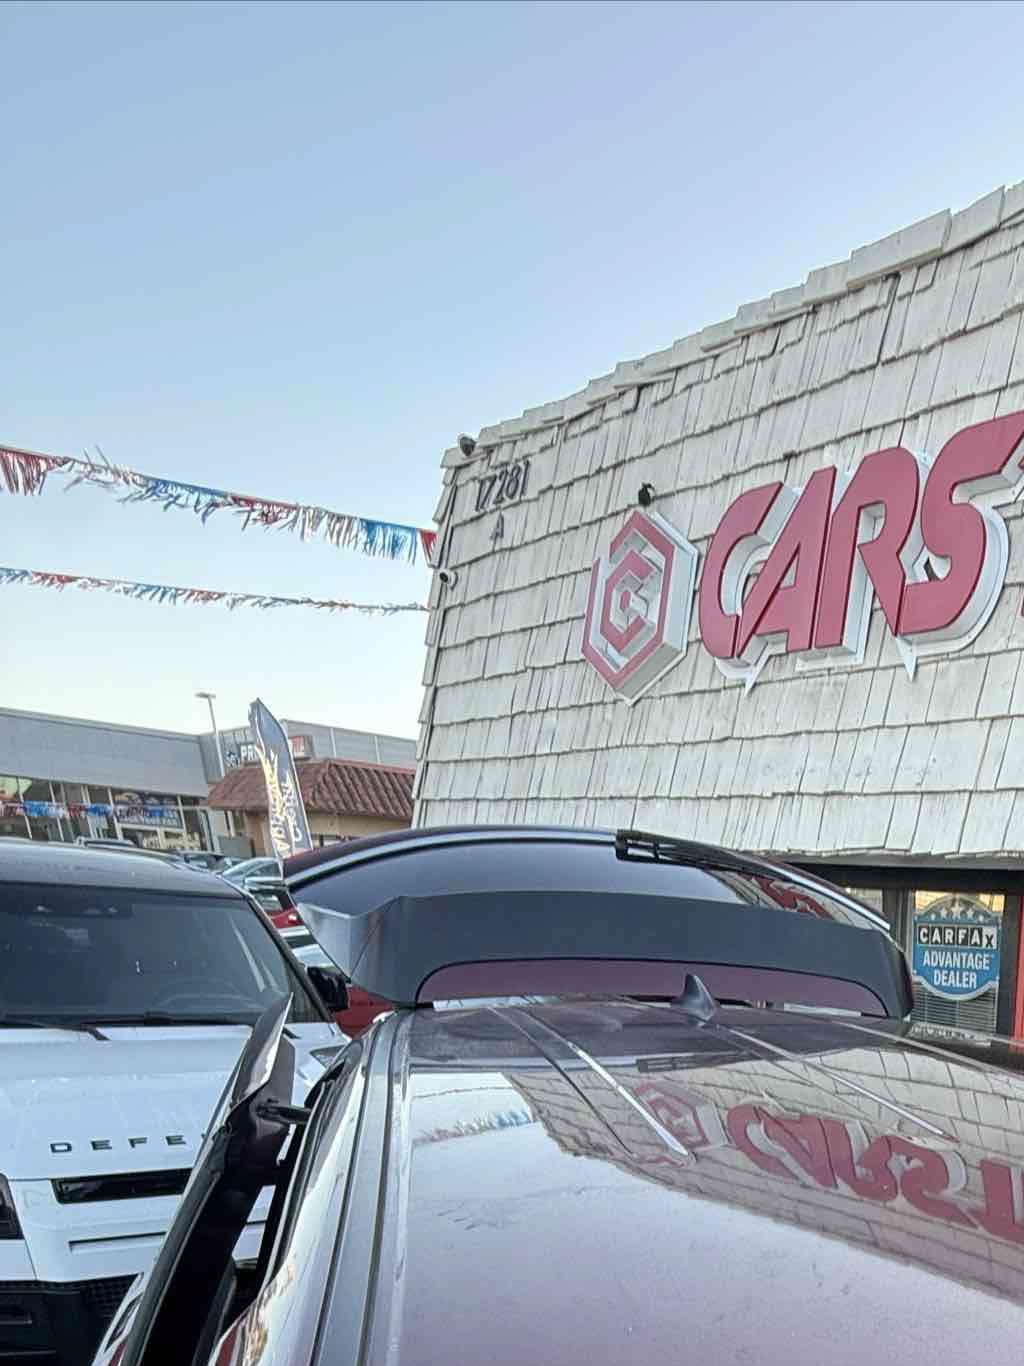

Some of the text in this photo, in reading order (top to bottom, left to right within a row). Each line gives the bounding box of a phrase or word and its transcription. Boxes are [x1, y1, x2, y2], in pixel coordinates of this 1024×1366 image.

[474, 458, 531, 512] 17281
[919, 926, 995, 949] CARFAX
[923, 951, 990, 971] ADVANTAGE
[933, 969, 977, 989] DEALER
[50, 1133, 208, 1153] DEFE
